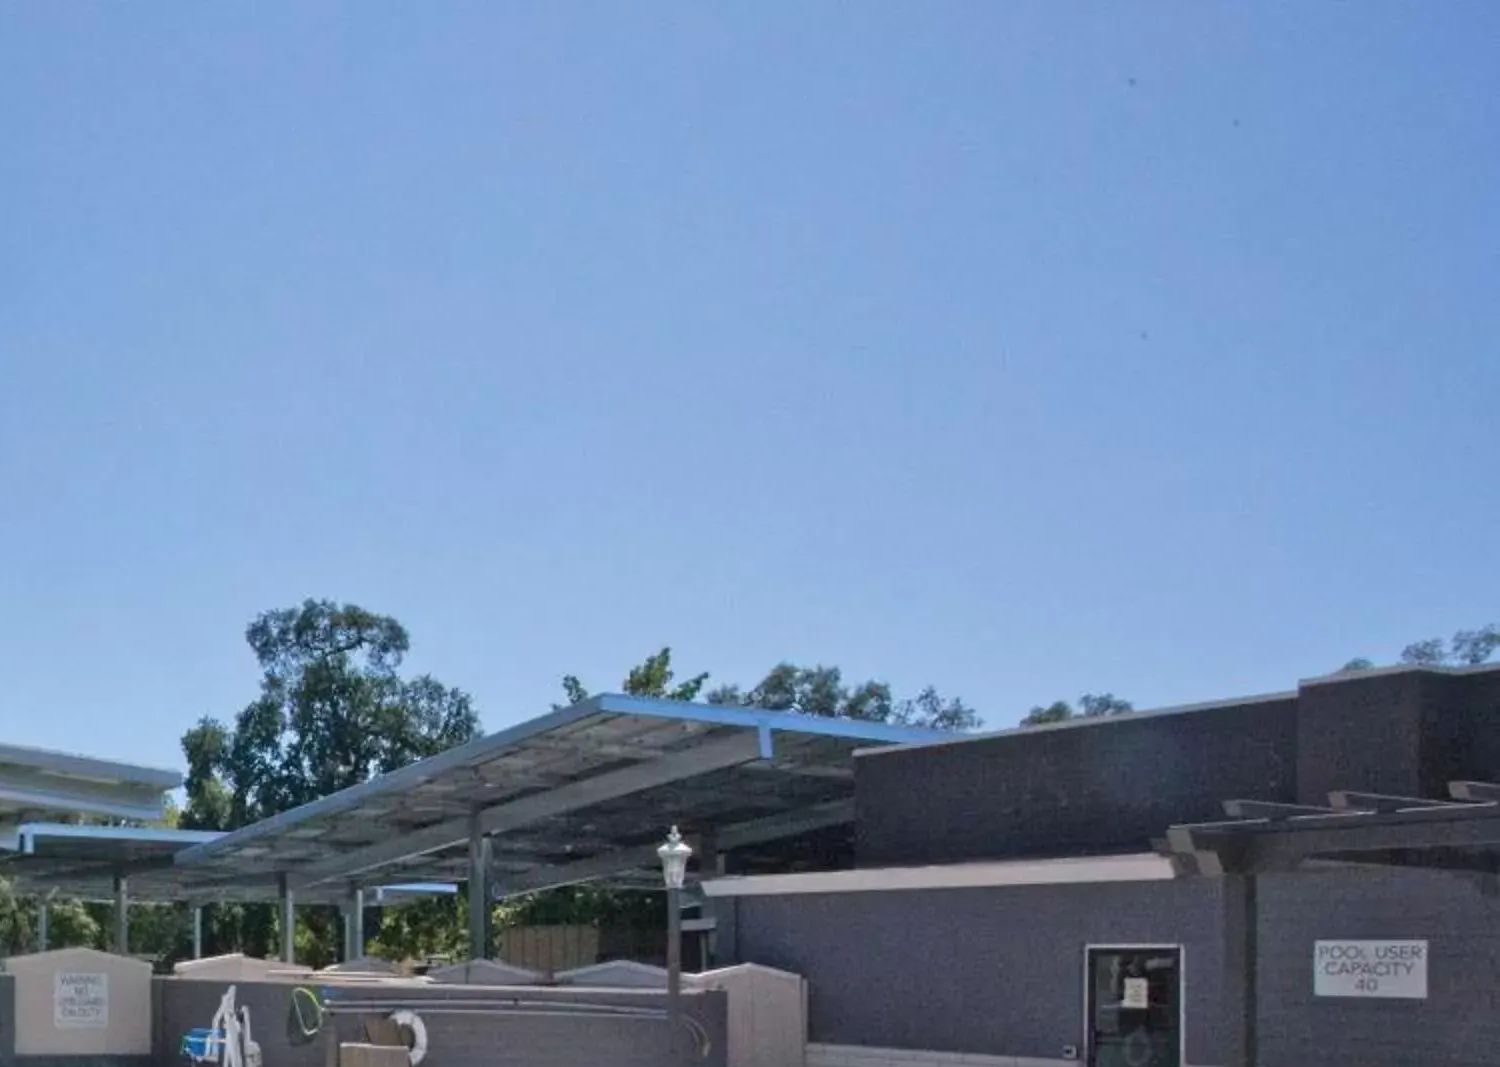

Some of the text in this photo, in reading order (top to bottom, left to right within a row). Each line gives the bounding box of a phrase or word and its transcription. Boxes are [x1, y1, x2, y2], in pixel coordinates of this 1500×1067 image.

[1318, 945, 1422, 960] POOL USER
[1325, 962, 1414, 976] CAPACITY
